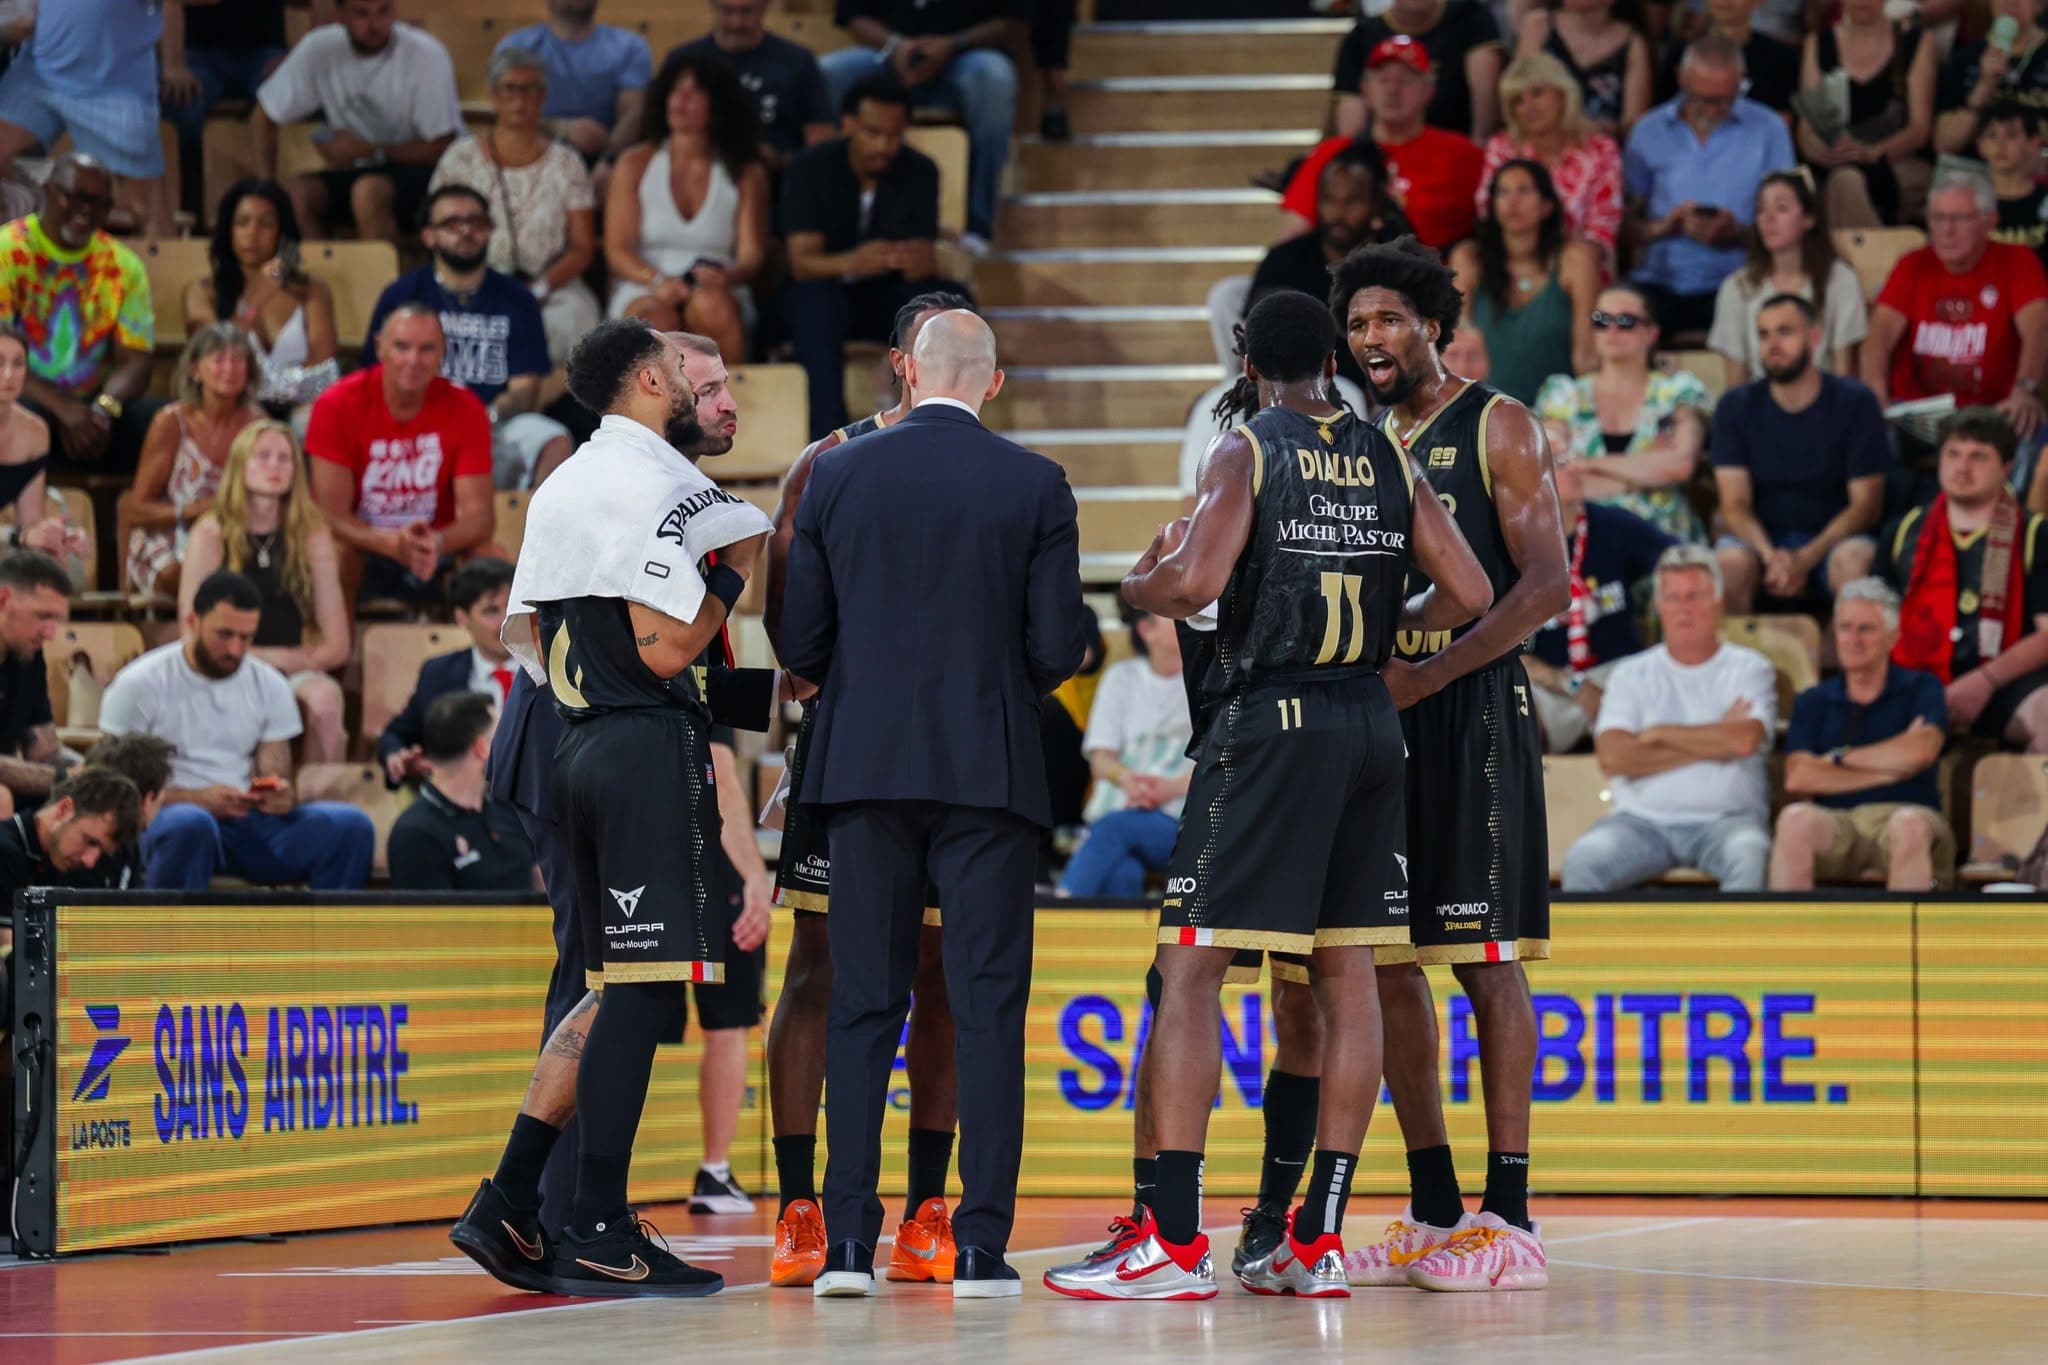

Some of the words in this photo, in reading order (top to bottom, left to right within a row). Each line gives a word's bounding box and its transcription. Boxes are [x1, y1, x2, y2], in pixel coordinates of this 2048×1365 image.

[1297, 449, 1375, 487] DIALLO
[1314, 571, 1364, 665] 11
[1277, 698, 1302, 731] 11
[807, 854, 831, 869] GRO
[604, 922, 665, 935] CUPRA
[1444, 920, 1482, 931] SPALDING
[1058, 993, 1278, 1110] SN
[1450, 992, 1849, 1103] BITRE.
[153, 1001, 249, 1143] SANS
[263, 1003, 419, 1133] ARBITRE.
